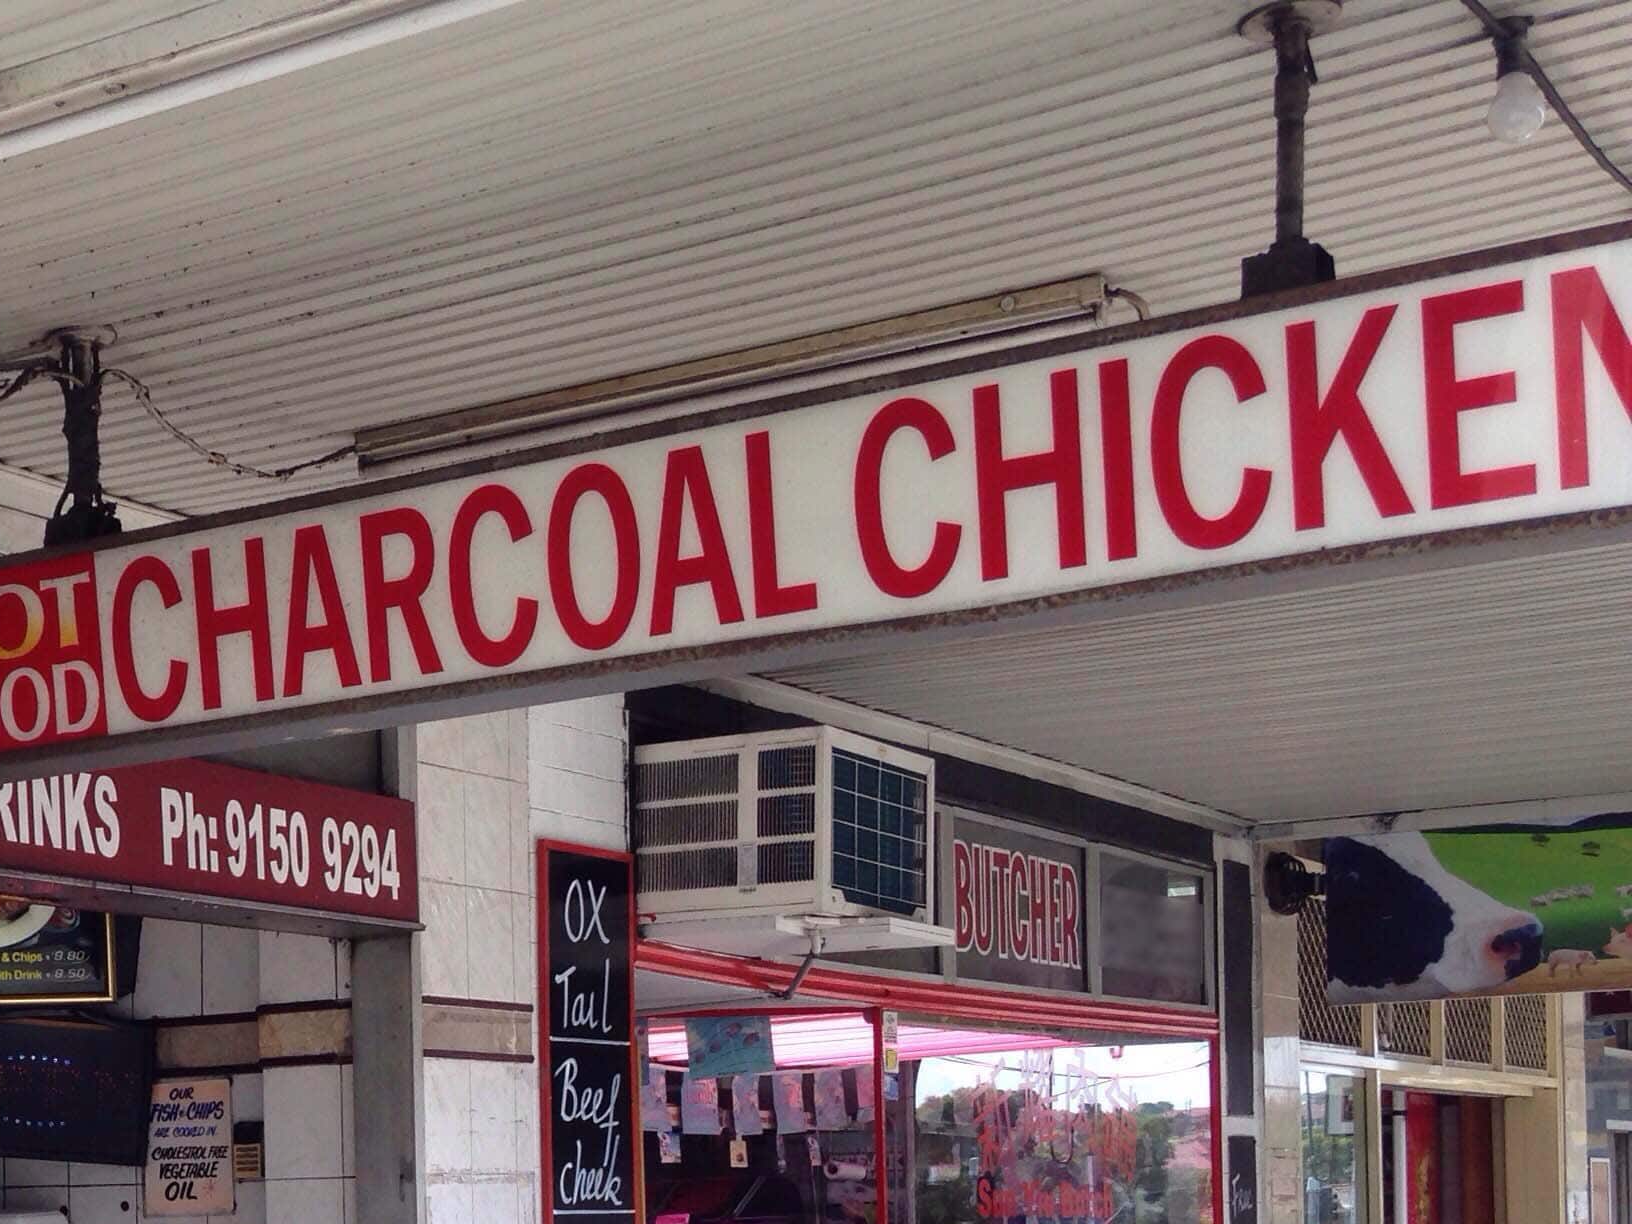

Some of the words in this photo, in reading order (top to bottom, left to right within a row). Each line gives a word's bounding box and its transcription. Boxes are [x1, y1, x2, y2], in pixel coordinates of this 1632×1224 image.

[112, 429, 818, 723] CHARCOAL
[855, 265, 1632, 597] CHICKEN
[323, 816, 402, 901] 9294
[953, 838, 1082, 970] BUTCHER
[1, 952, 10, 963] &
[12, 951, 43, 963] Chips
[14, 969, 42, 980] Drink
[555, 958, 612, 1033] Tail
[169, 1087, 194, 1100] OUR
[151, 1103, 180, 1122] FISH
[187, 1100, 224, 1120] CHIPS
[554, 1057, 622, 1167] Beef
[154, 1126, 170, 1138] ARE
[173, 1126, 205, 1138] COOKED
[207, 1126, 217, 1137] IN
[208, 1145, 229, 1159] FREE
[159, 1161, 220, 1179] VEGETABLE
[164, 1181, 198, 1201] OIL
